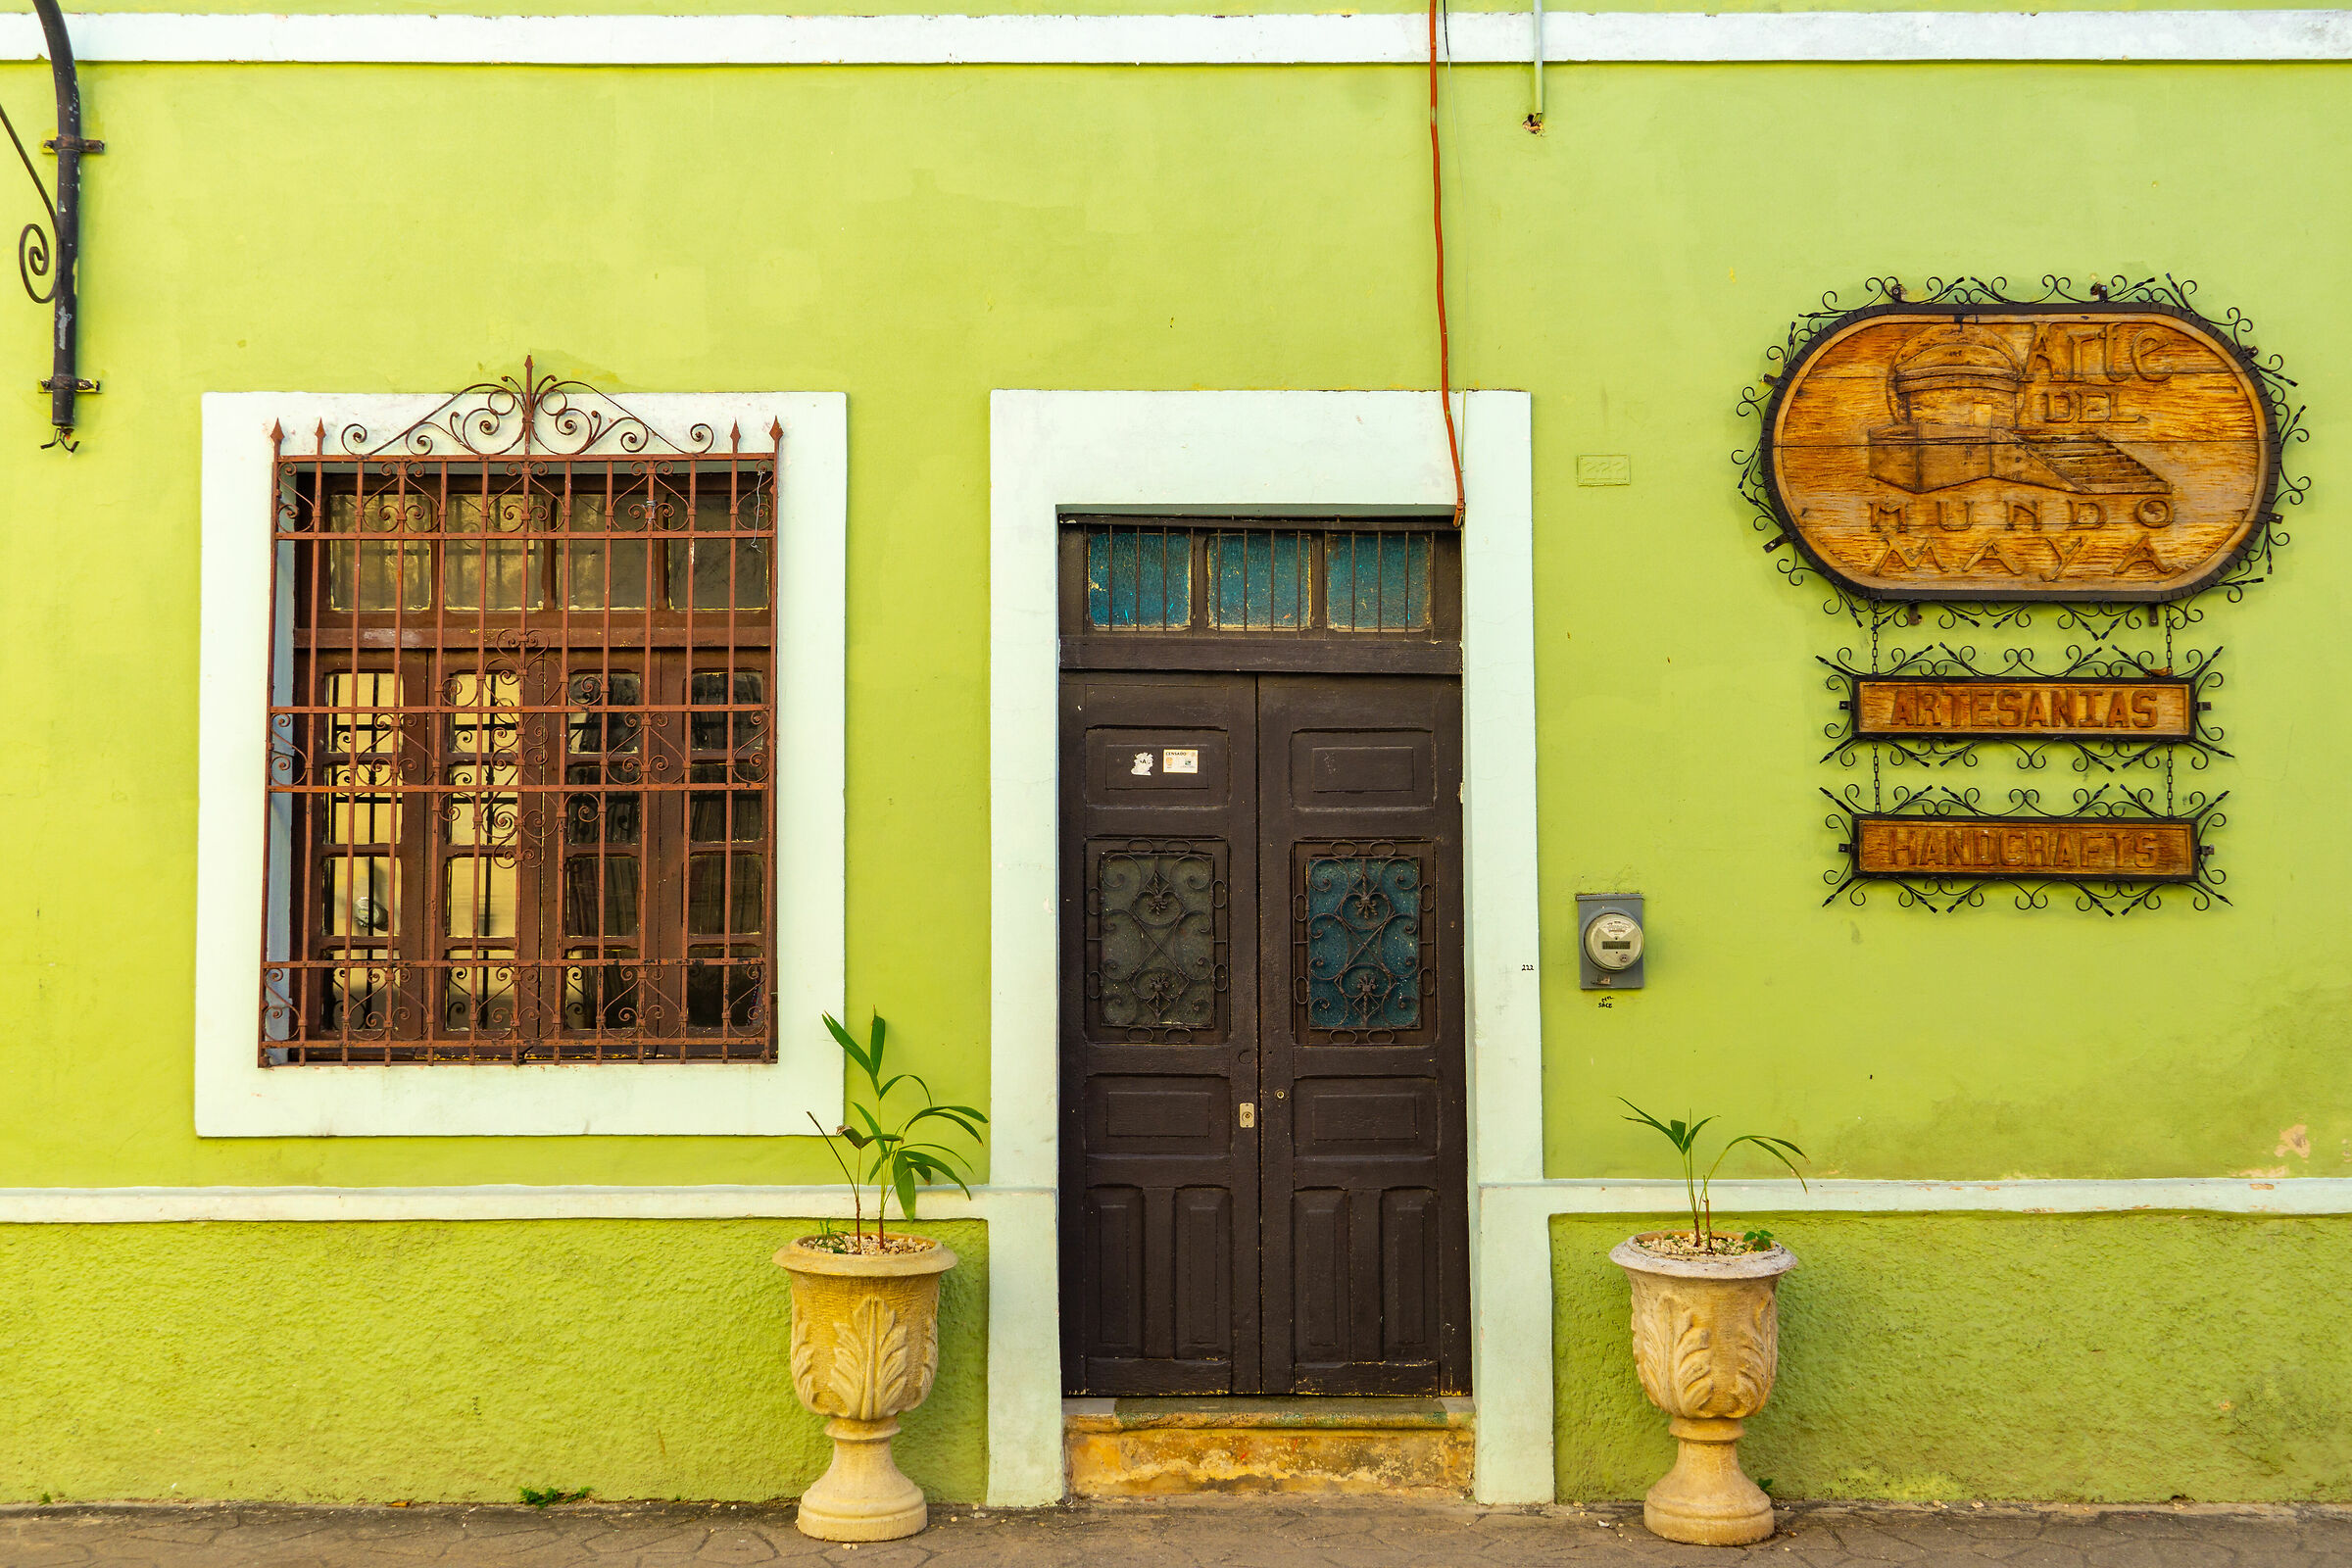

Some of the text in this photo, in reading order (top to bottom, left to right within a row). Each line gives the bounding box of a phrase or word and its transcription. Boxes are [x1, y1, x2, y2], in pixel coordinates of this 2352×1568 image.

[2022, 322, 2175, 383] Arte
[2042, 390, 2148, 423] DEL
[1869, 497, 2174, 533] MUNDO
[1875, 536, 2179, 582] MAYA
[1890, 689, 2157, 729] ARTESANIAS
[1888, 829, 2156, 868] HANDCRAFTS
